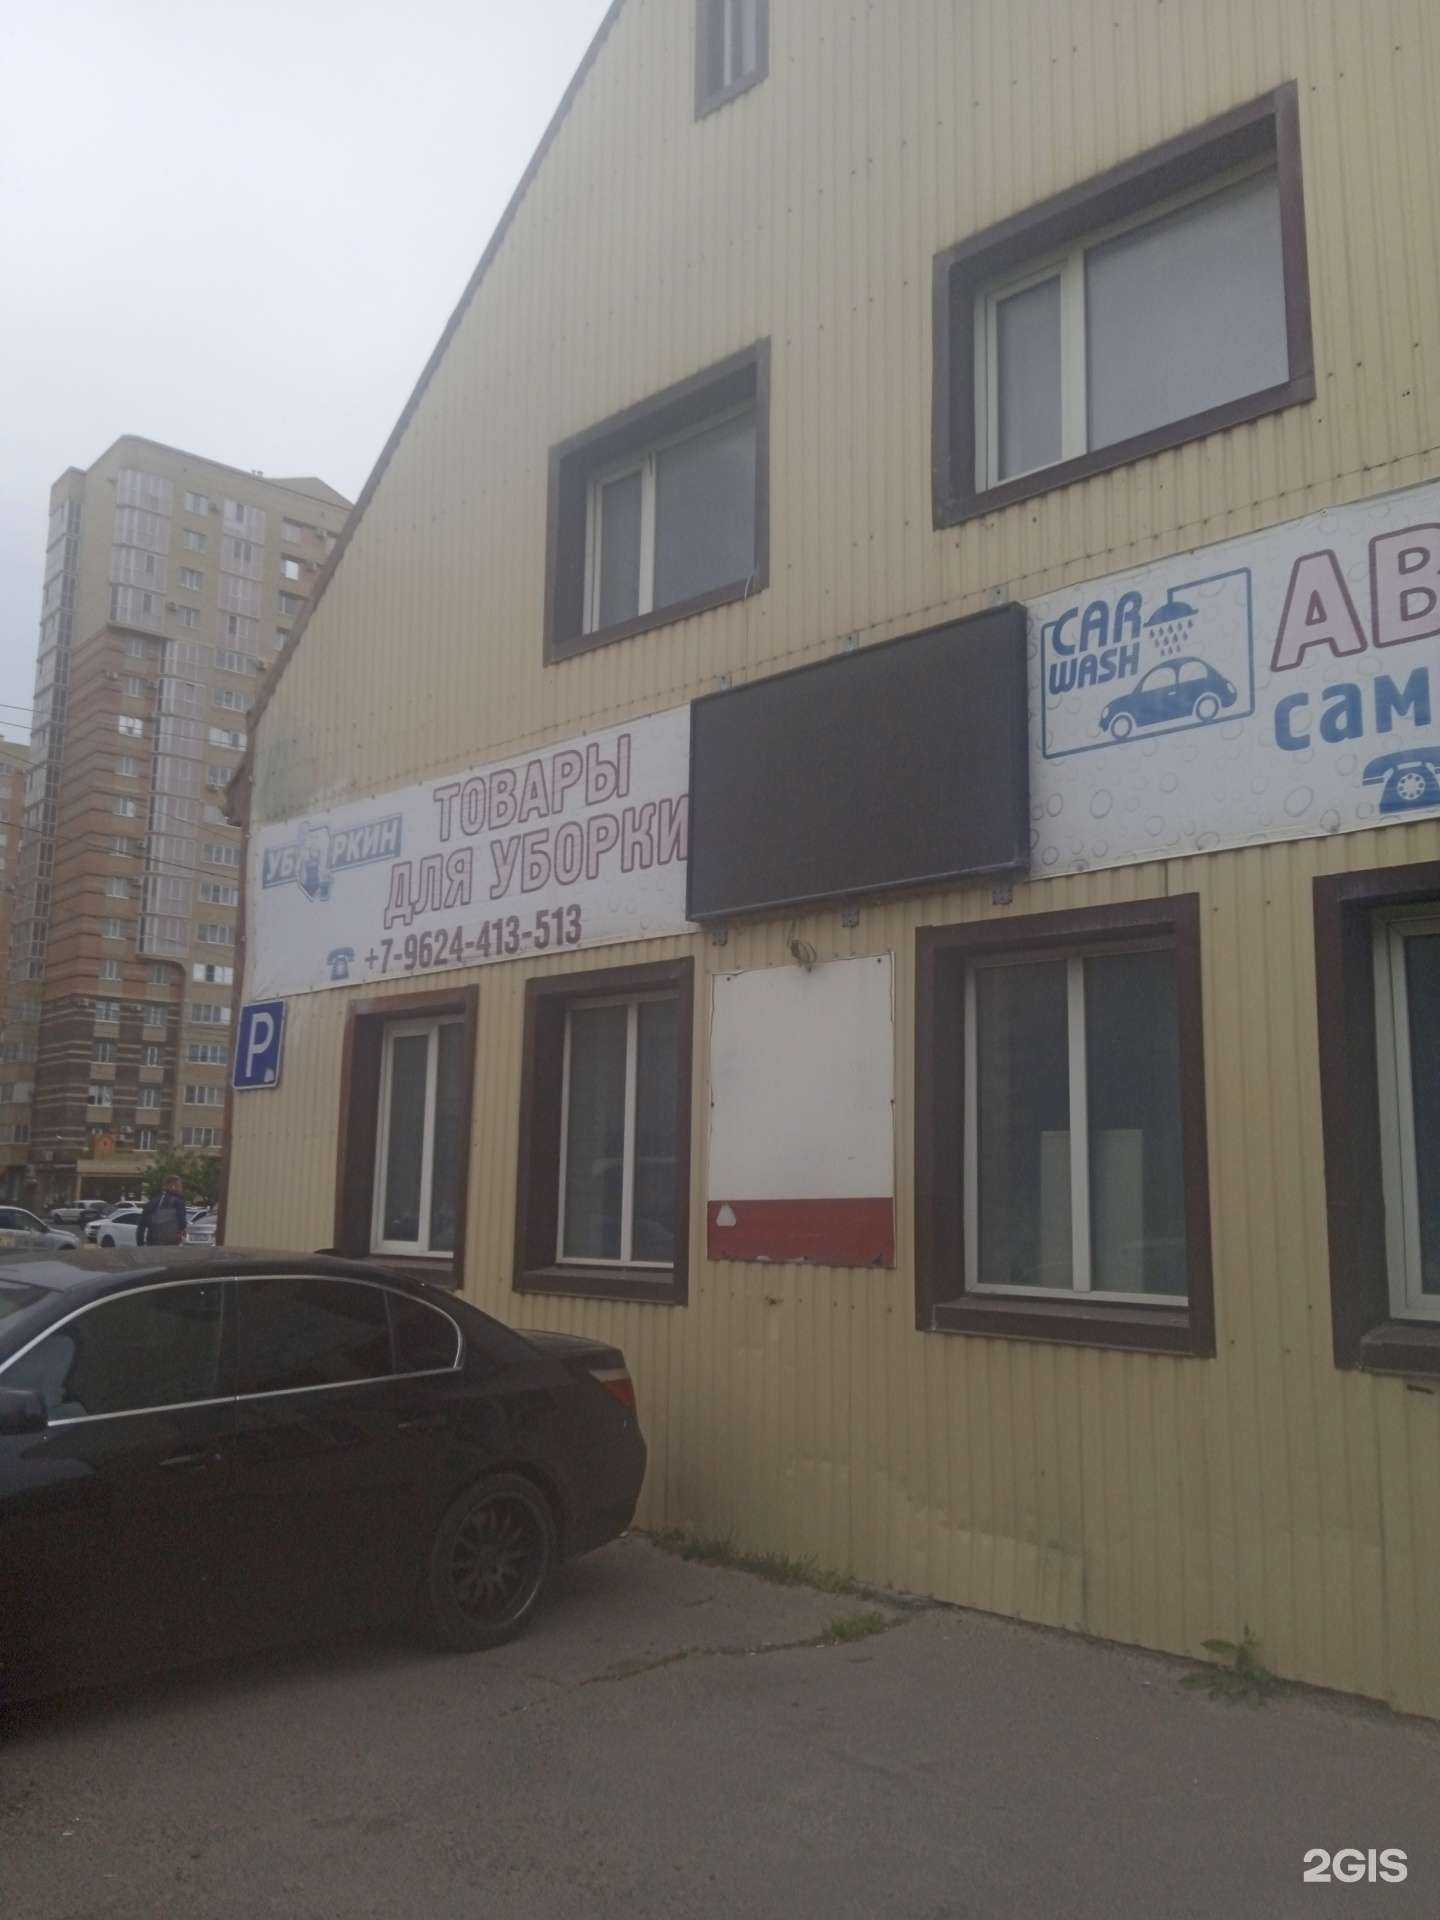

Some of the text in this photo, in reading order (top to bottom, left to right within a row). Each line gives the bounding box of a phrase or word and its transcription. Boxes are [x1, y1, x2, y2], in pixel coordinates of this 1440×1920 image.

[1051, 590, 1143, 656] CAR
[1048, 643, 1141, 696] WASH
[433, 733, 632, 842] ТОВАРЫ
[267, 819, 401, 881] УБРКИН
[383, 793, 689, 929] ДЛЯ УБОРКИ
[364, 903, 583, 974] +7-9624-413-513
[246, 1011, 275, 1078] P
